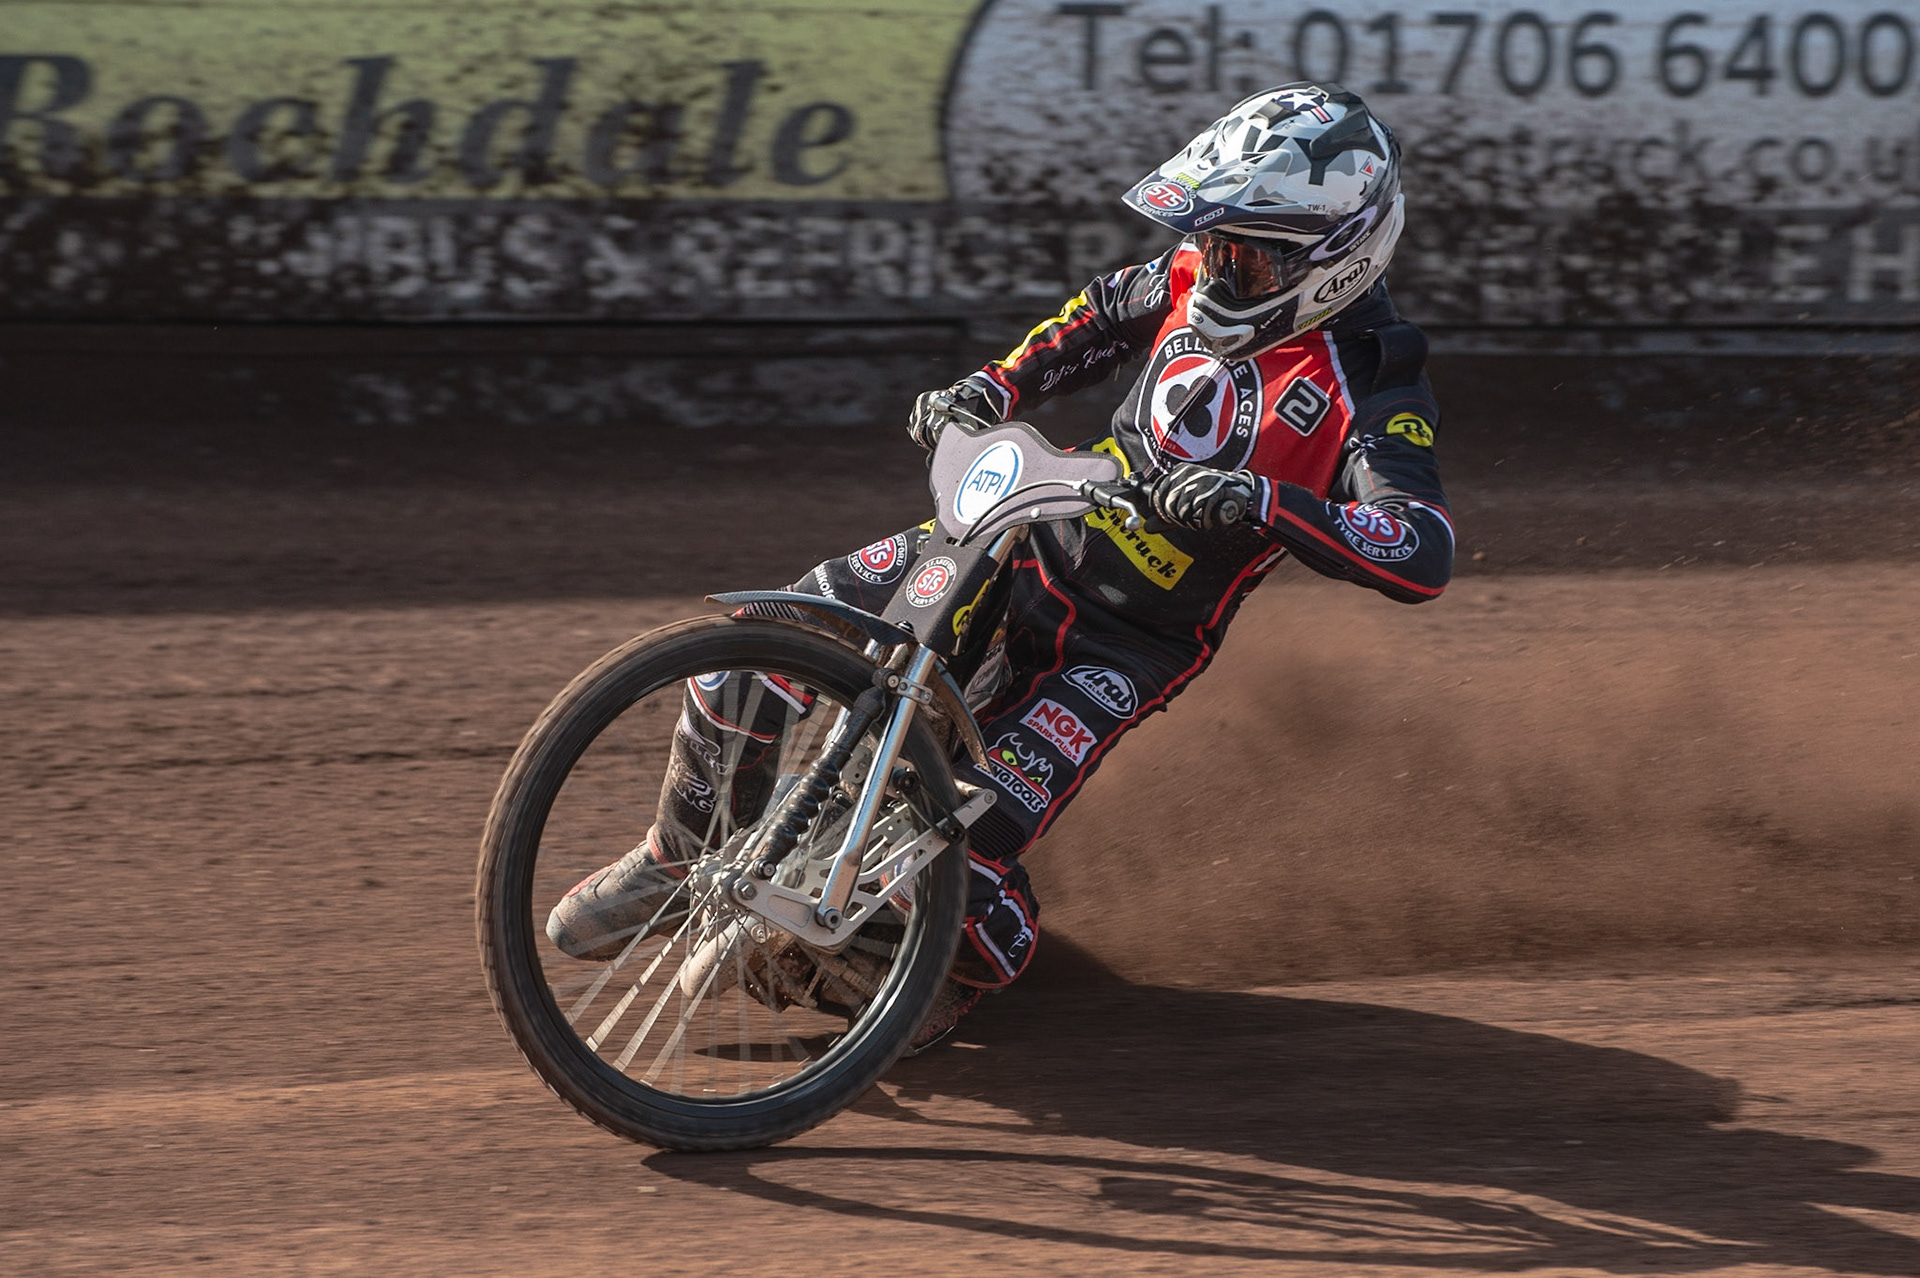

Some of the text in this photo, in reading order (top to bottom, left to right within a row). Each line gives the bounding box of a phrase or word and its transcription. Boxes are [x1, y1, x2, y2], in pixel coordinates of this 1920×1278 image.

[1058, 4, 1913, 97] Tel: 01706 6400
[0, 54, 857, 188] Rochdale
[1146, 185, 1187, 208] STS
[1324, 261, 1366, 300] Arai
[1235, 387, 1255, 438] ACES
[967, 469, 1007, 496] ATPI
[1334, 517, 1362, 546] TYRE
[1351, 509, 1395, 538] STS
[918, 569, 944, 592] STS
[1082, 680, 1111, 704] HELMET
[1026, 719, 1078, 762] SPARK PLUGS
[1032, 701, 1093, 755] NGK
